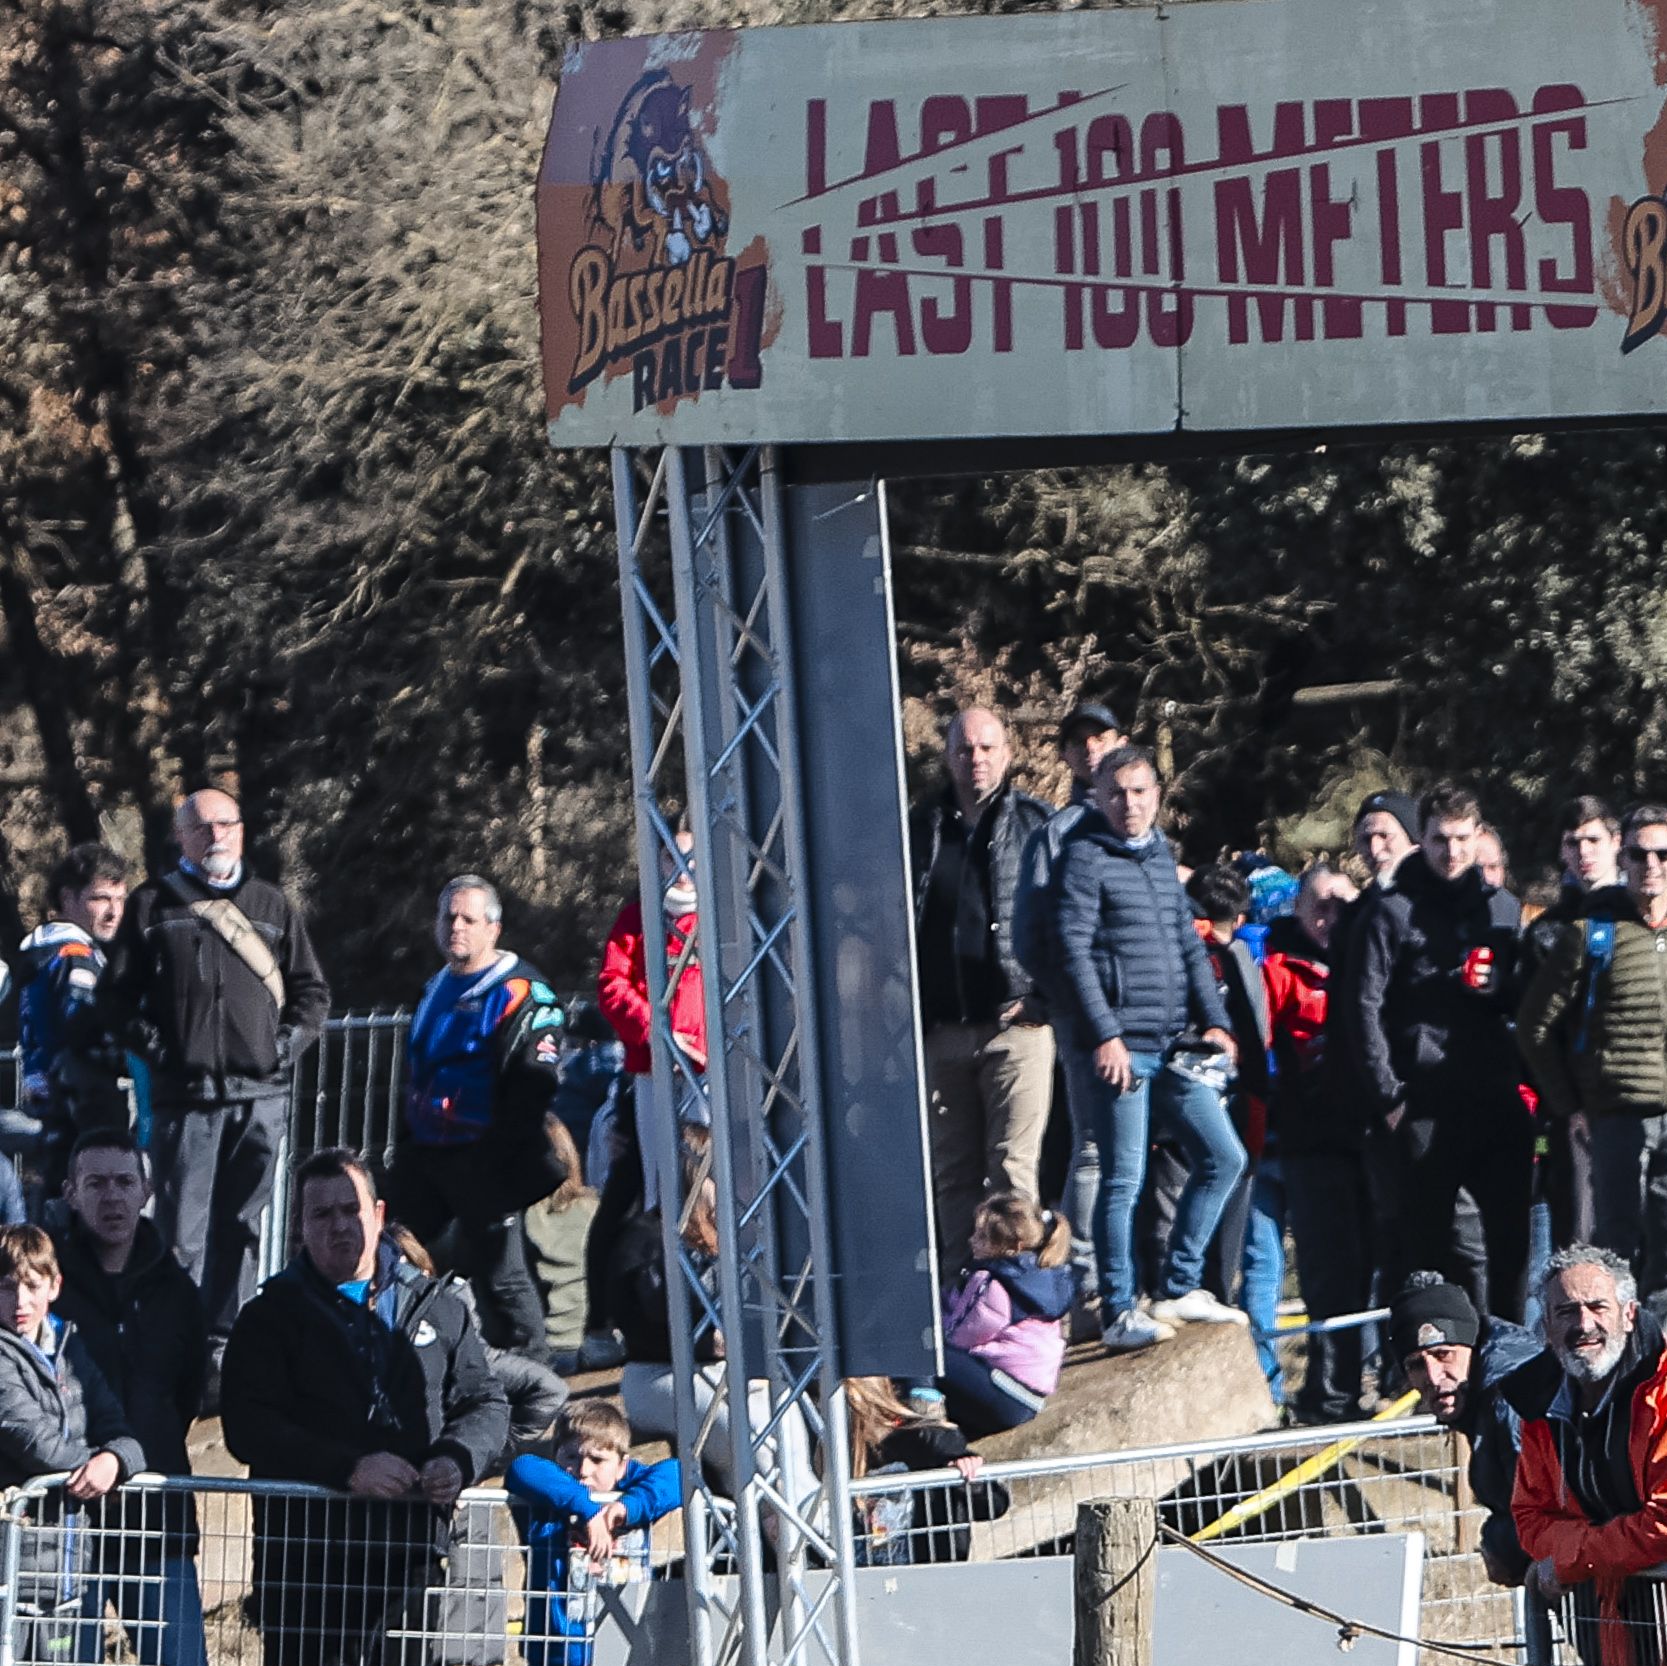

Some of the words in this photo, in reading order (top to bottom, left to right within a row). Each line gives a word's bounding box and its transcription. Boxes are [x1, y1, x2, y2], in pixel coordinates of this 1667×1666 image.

[803, 94, 1028, 359] LAST
[1054, 90, 1195, 351] 100
[1213, 84, 1598, 345] METERS
[568, 245, 736, 395] Bassella
[633, 325, 731, 415] RACE
[729, 264, 768, 390] 1
